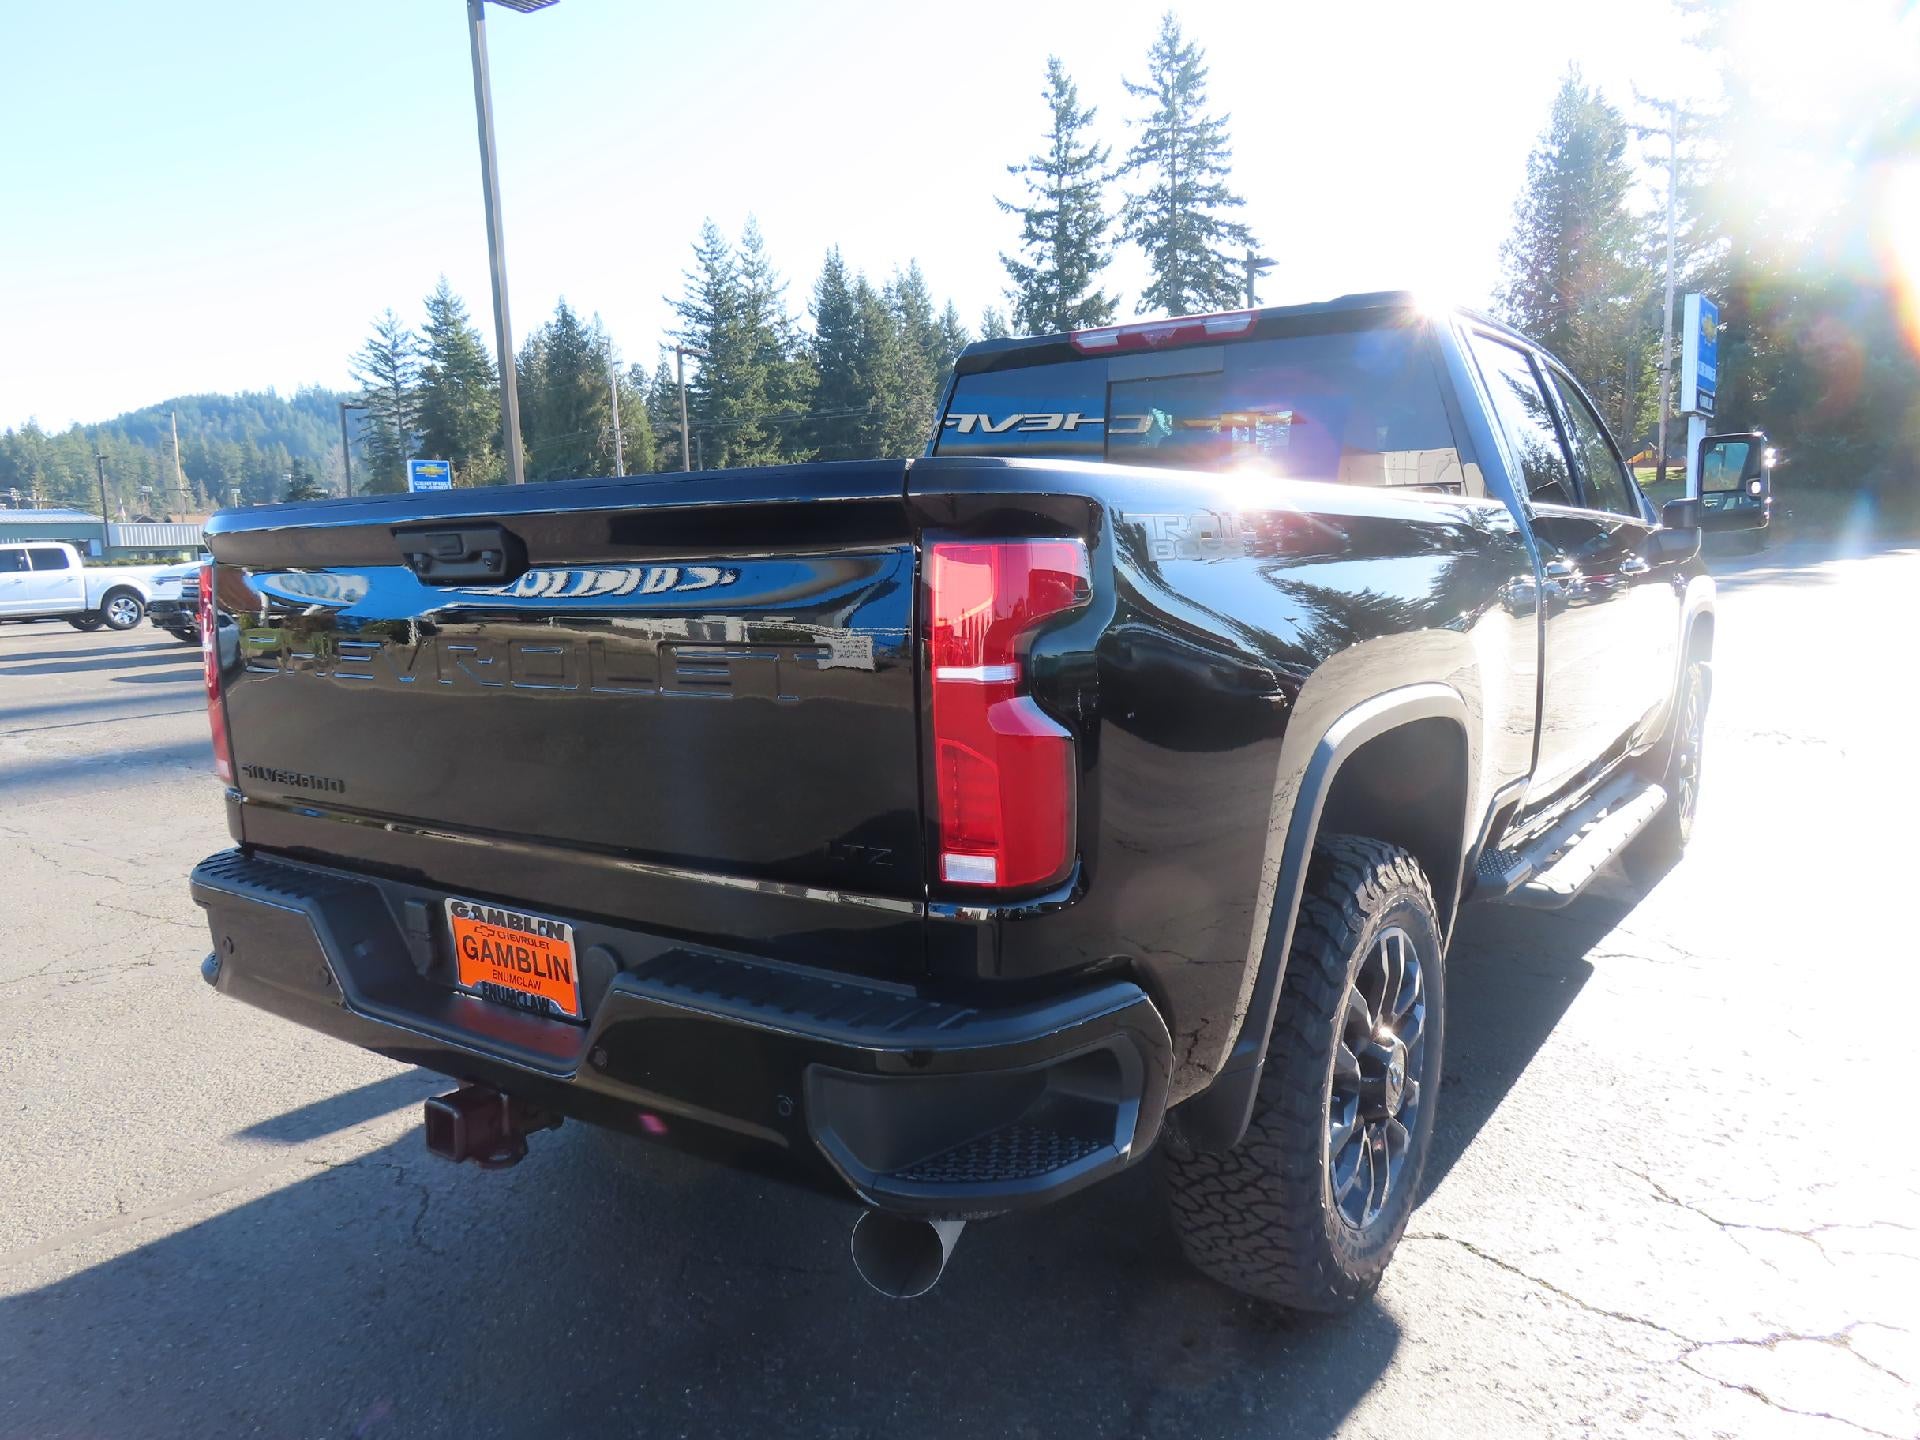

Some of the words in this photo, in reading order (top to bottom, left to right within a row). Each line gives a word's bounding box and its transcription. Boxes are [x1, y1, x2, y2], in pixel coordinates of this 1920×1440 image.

[240, 634, 833, 701] CHEVROLET
[451, 902, 565, 941] GAMBLIN
[497, 930, 550, 950] CHEVROLET
[462, 935, 571, 985] GAMBLIN
[492, 969, 541, 991] ENUMCLAW
